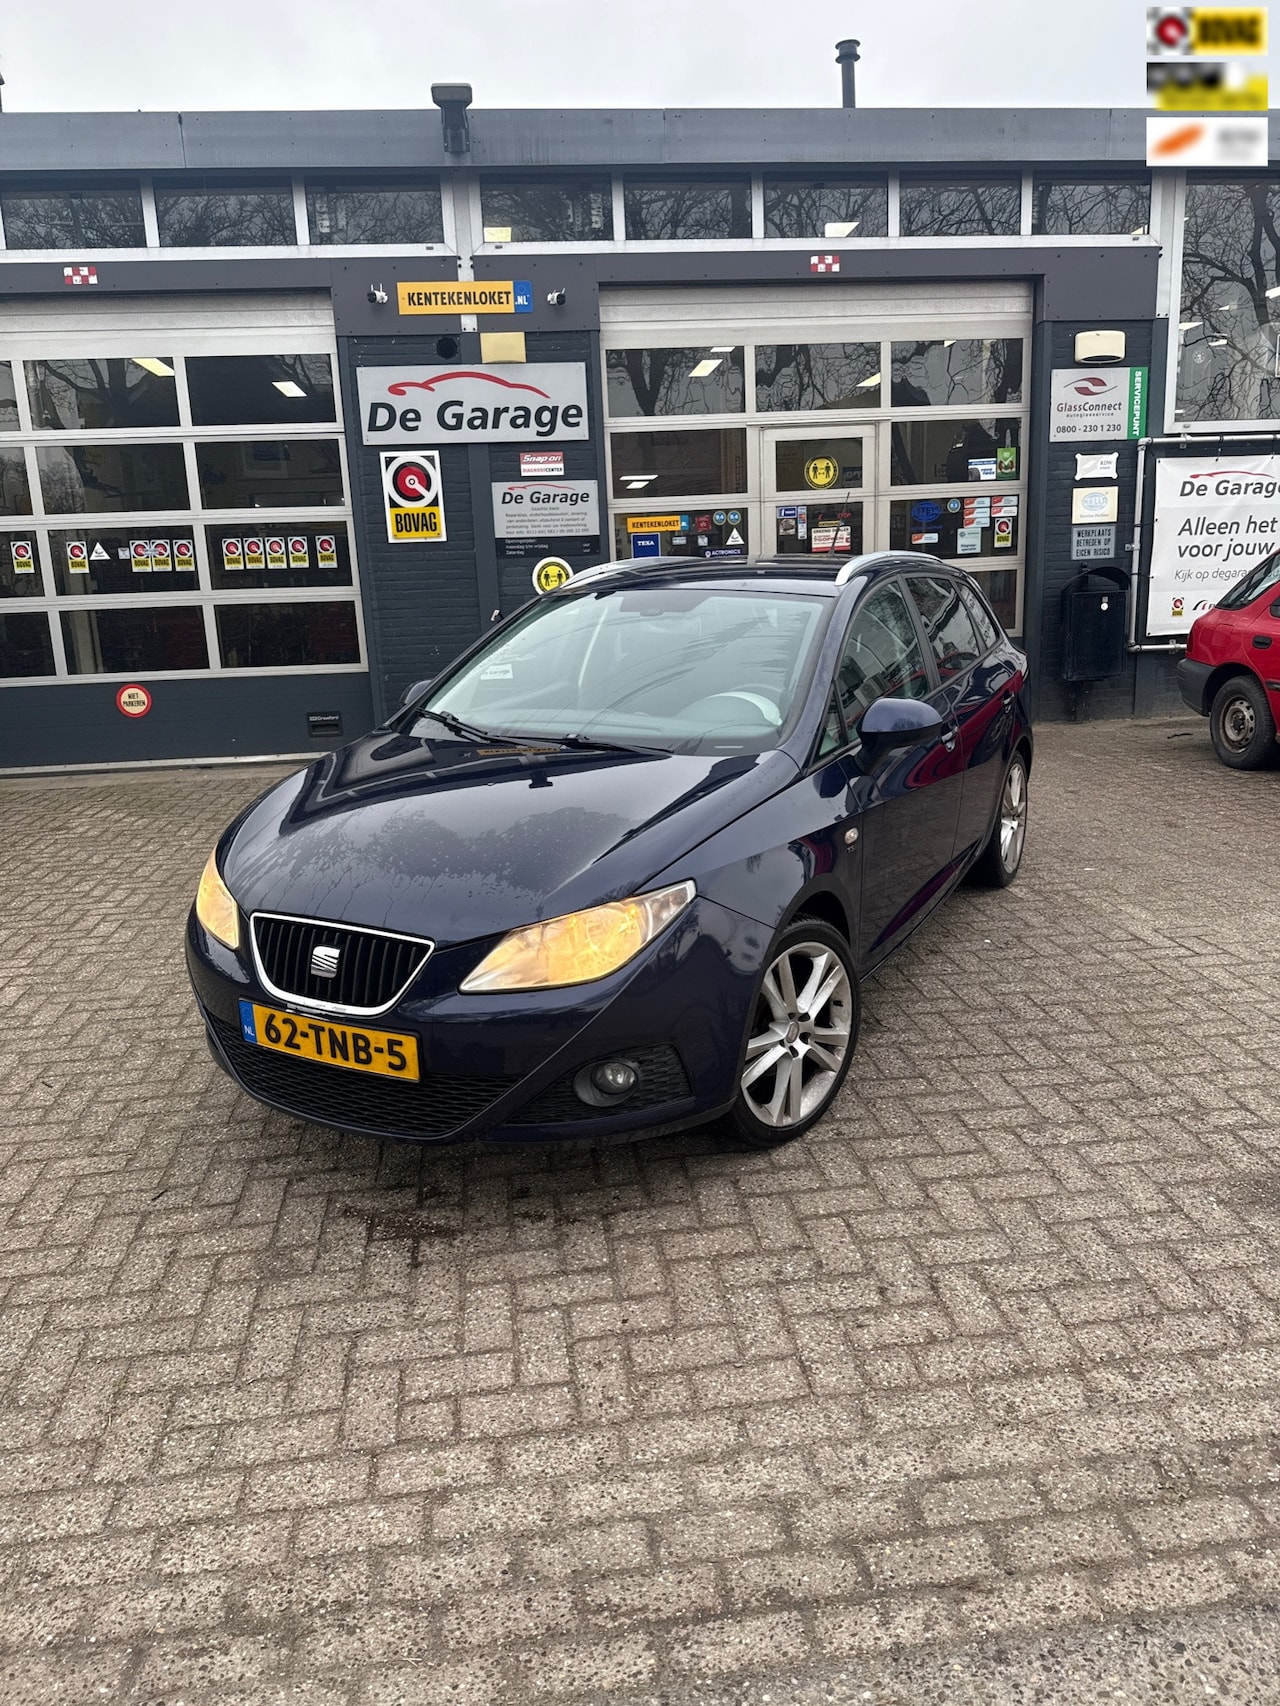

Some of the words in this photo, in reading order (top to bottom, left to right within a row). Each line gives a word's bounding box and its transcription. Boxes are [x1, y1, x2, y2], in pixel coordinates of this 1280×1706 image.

[407, 290, 512, 306] KENTEKENLOKET
[1056, 401, 1122, 413] GlassConnect
[1131, 370, 1142, 436] SERVICEPUNT
[367, 401, 422, 432] De
[436, 400, 583, 437] Garage
[1056, 424, 1077, 433] 0800
[1083, 424, 1098, 433] 230
[1106, 423, 1121, 432] 230
[523, 454, 562, 463] Snap-on
[1179, 480, 1208, 497] De
[501, 491, 524, 505] De
[529, 490, 590, 506] Garage
[394, 511, 438, 534] BOVAG
[631, 520, 680, 529] KENTEKENLOKET
[1177, 516, 1240, 536] Alleen
[1245, 514, 1278, 534] het
[1076, 528, 1112, 538] WERKPLAATS
[1076, 538, 1101, 547] BETREDEN
[1104, 538, 1111, 546] OP
[1177, 544, 1222, 558] voor
[1222, 538, 1276, 562] jouw
[1093, 547, 1111, 556] RISICO
[1174, 569, 1193, 584] Kijk
[1195, 570, 1209, 583] op
[1212, 567, 1252, 582] degara
[244, 1024, 255, 1037] NL
[264, 1012, 408, 1071] 62-TNB-5
